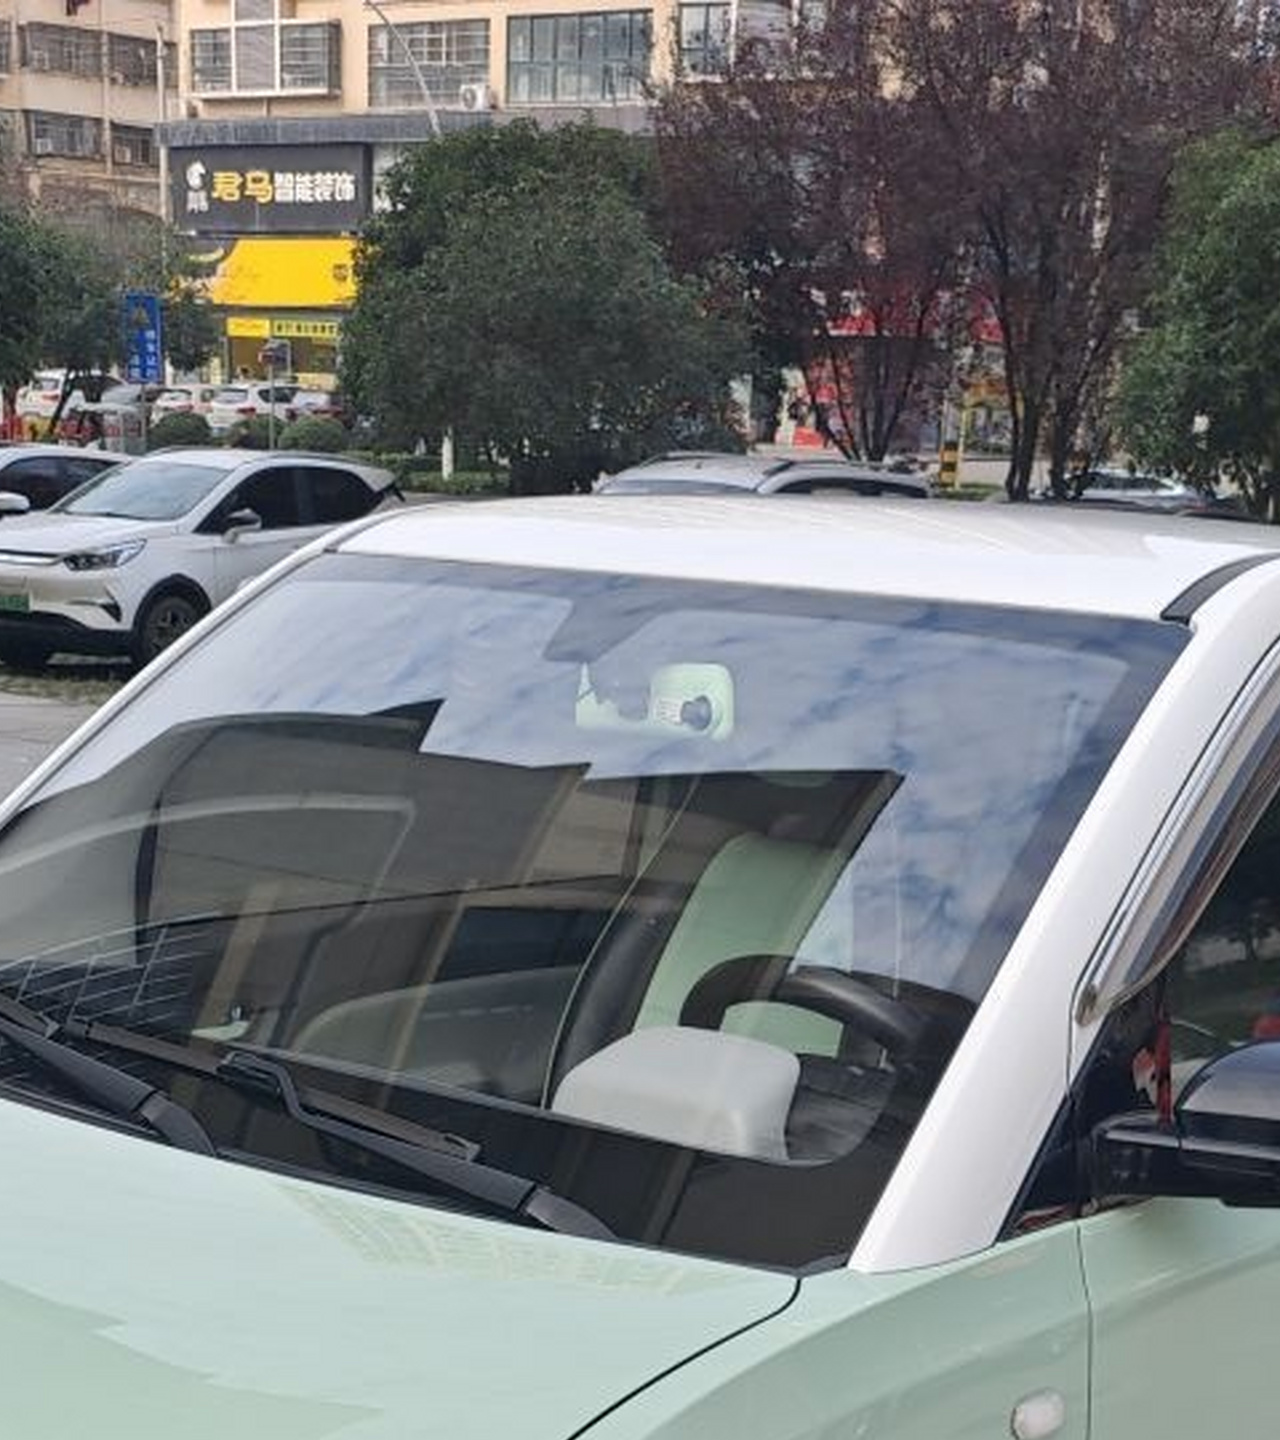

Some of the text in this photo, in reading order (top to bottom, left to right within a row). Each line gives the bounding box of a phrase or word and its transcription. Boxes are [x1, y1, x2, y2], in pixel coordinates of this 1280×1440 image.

[211, 170, 356, 203] 君马智能装饰
